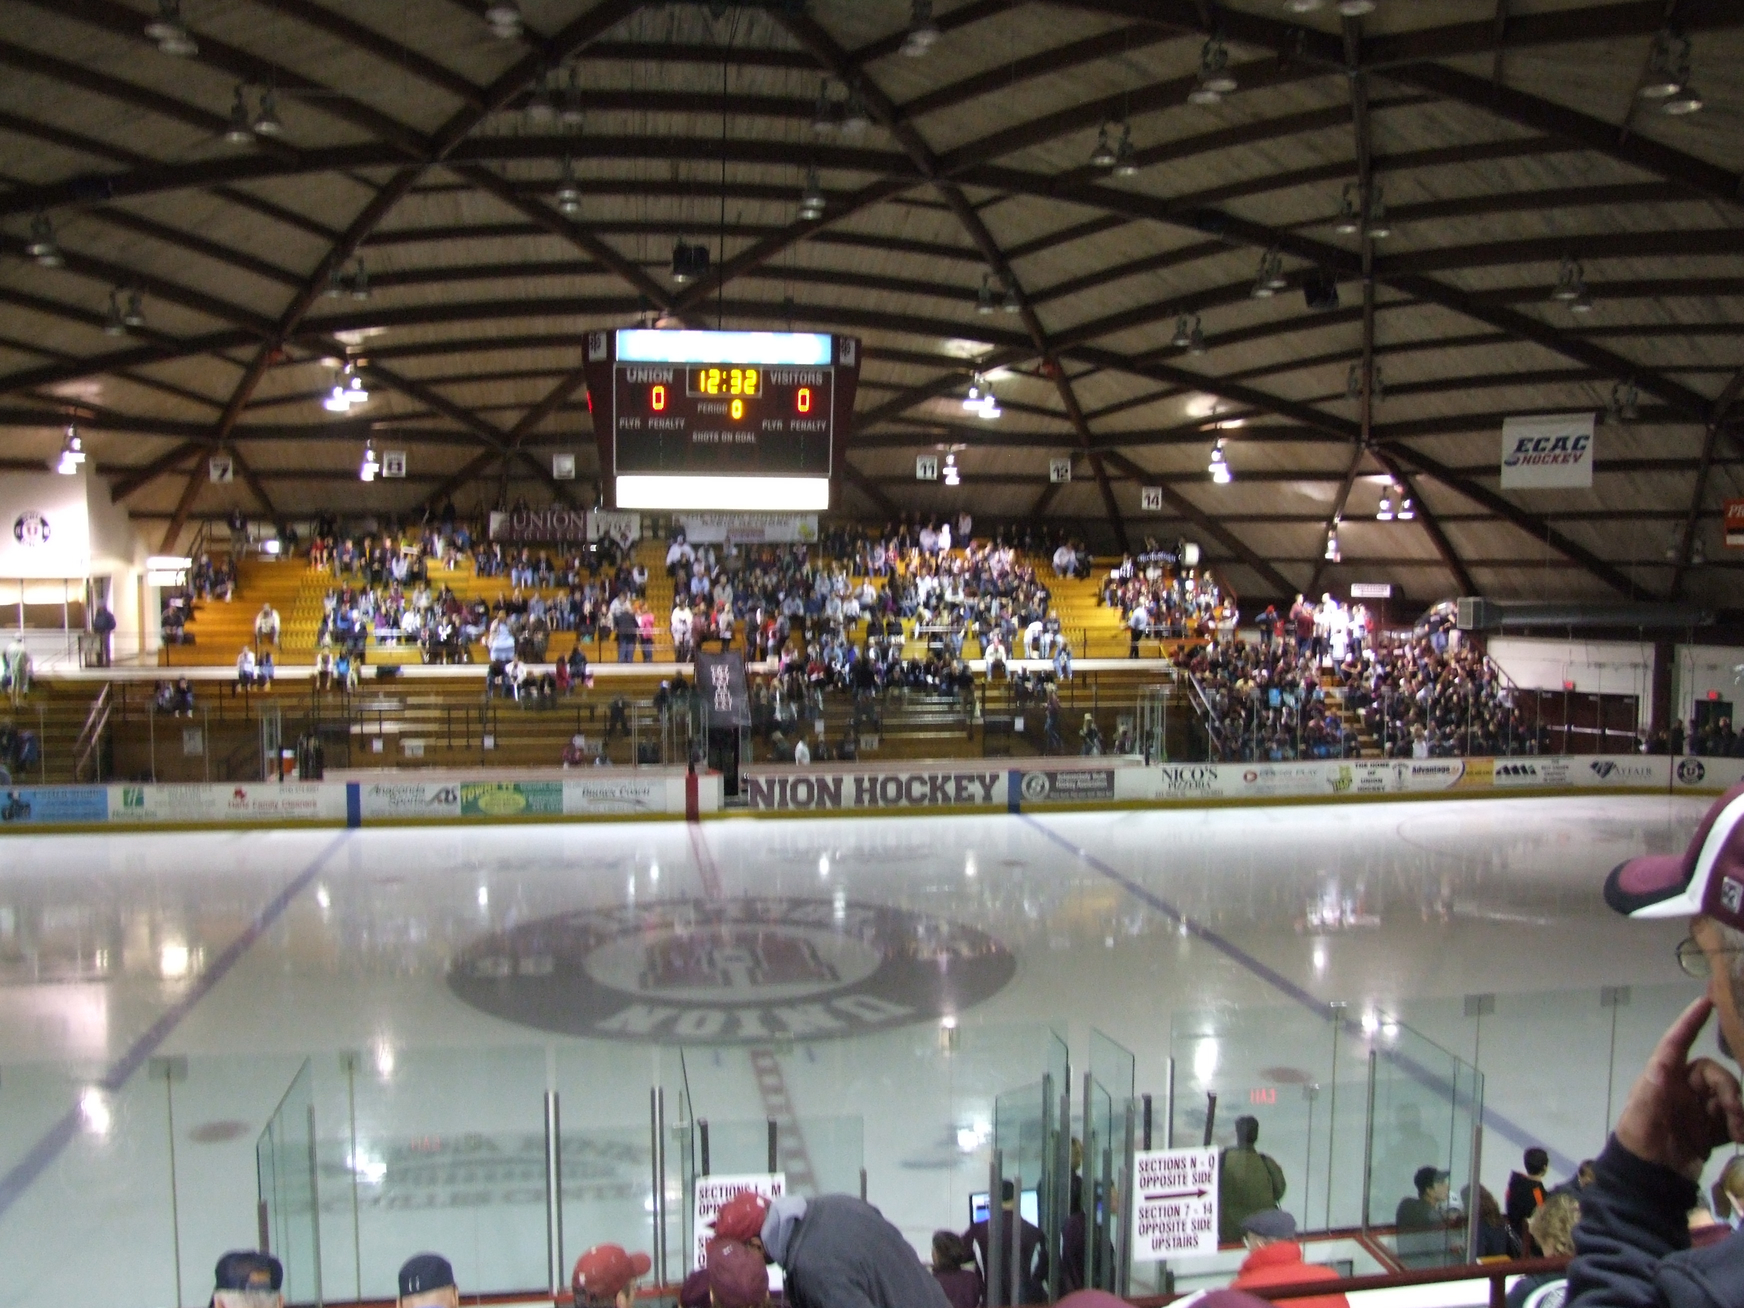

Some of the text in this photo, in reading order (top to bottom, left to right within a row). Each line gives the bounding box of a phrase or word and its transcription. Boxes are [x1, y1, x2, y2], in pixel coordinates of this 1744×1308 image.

[625, 367, 674, 384] UNION
[699, 368, 758, 395] 12:32
[769, 370, 823, 385] VISITORS
[697, 402, 728, 415] PERIOD
[619, 417, 686, 430] PLYR PENALTY
[762, 419, 827, 432] PLYR PENALTY
[692, 431, 757, 444] SHOTS ON GOAL
[1513, 434, 1591, 454] ECAC
[1519, 453, 1584, 466] HOCKEY
[513, 510, 584, 530] UNION
[1162, 765, 1218, 782] NICO'S
[1412, 765, 1451, 775] Advantage
[854, 774, 1001, 808] HOCKEY
[1168, 781, 1211, 790] PIZZERIA
[1138, 1156, 1187, 1173] SECTIONS
[1190, 1155, 1197, 1169] N
[1139, 1170, 1213, 1189] OPPOSITE SIDE
[771, 1183, 782, 1197] M
[1138, 1205, 1181, 1220] SECTION
[1184, 1202, 1190, 1217] 7
[1203, 1201, 1213, 1215] 14
[1138, 1217, 1212, 1236] OPPOSITE SIDE
[1151, 1235, 1199, 1252] UPSTAIRS
